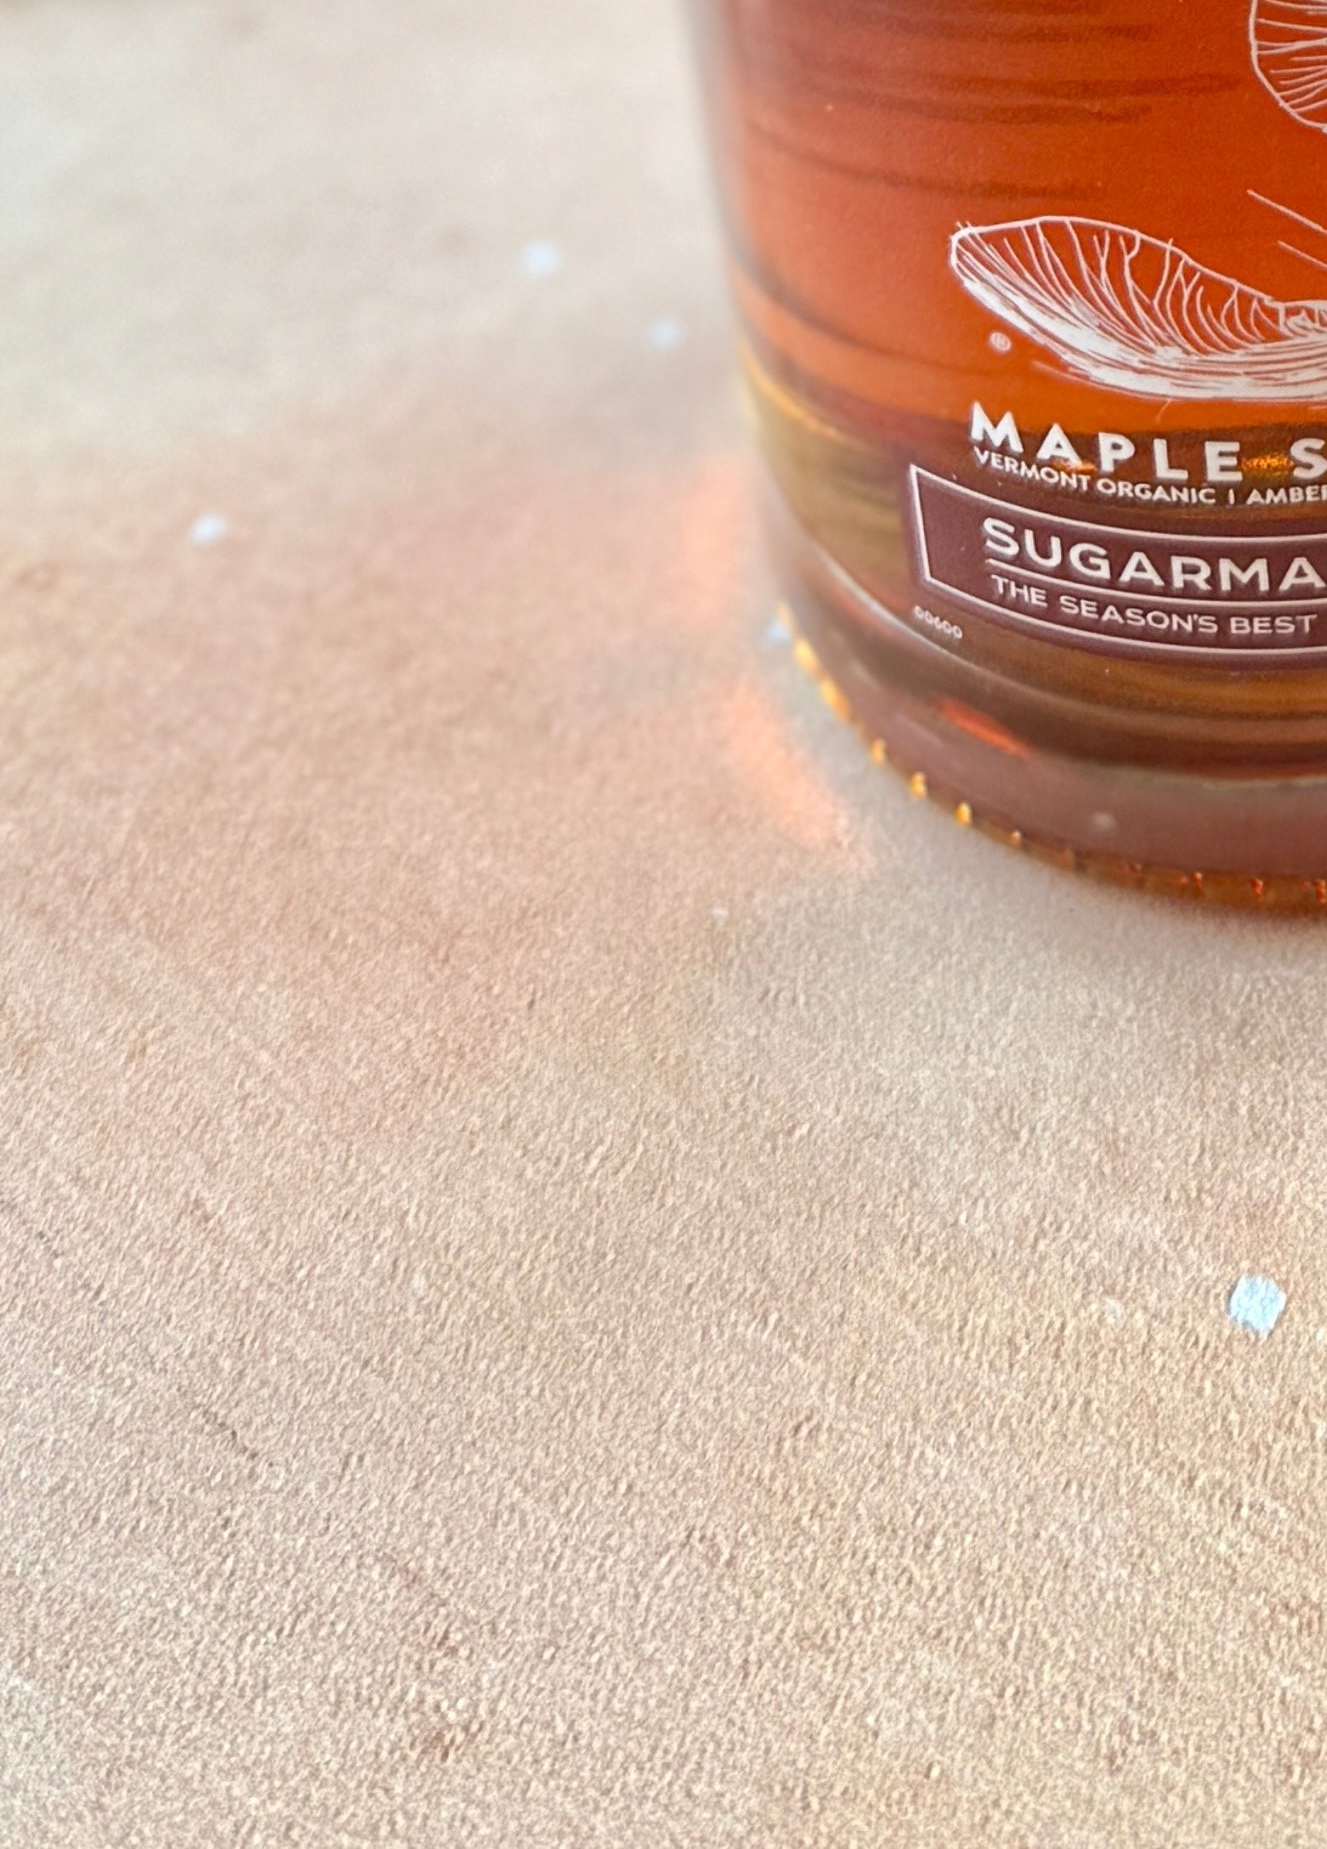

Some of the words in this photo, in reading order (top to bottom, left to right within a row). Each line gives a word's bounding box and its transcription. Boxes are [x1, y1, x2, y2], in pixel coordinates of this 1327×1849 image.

[969, 401, 1243, 483] MAPLE
[973, 447, 1090, 491] VERMONT
[1096, 476, 1216, 504] ORGANIC
[991, 574, 1047, 608] THE
[1060, 595, 1218, 634] SEASON'S
[1231, 614, 1317, 634] BEST
